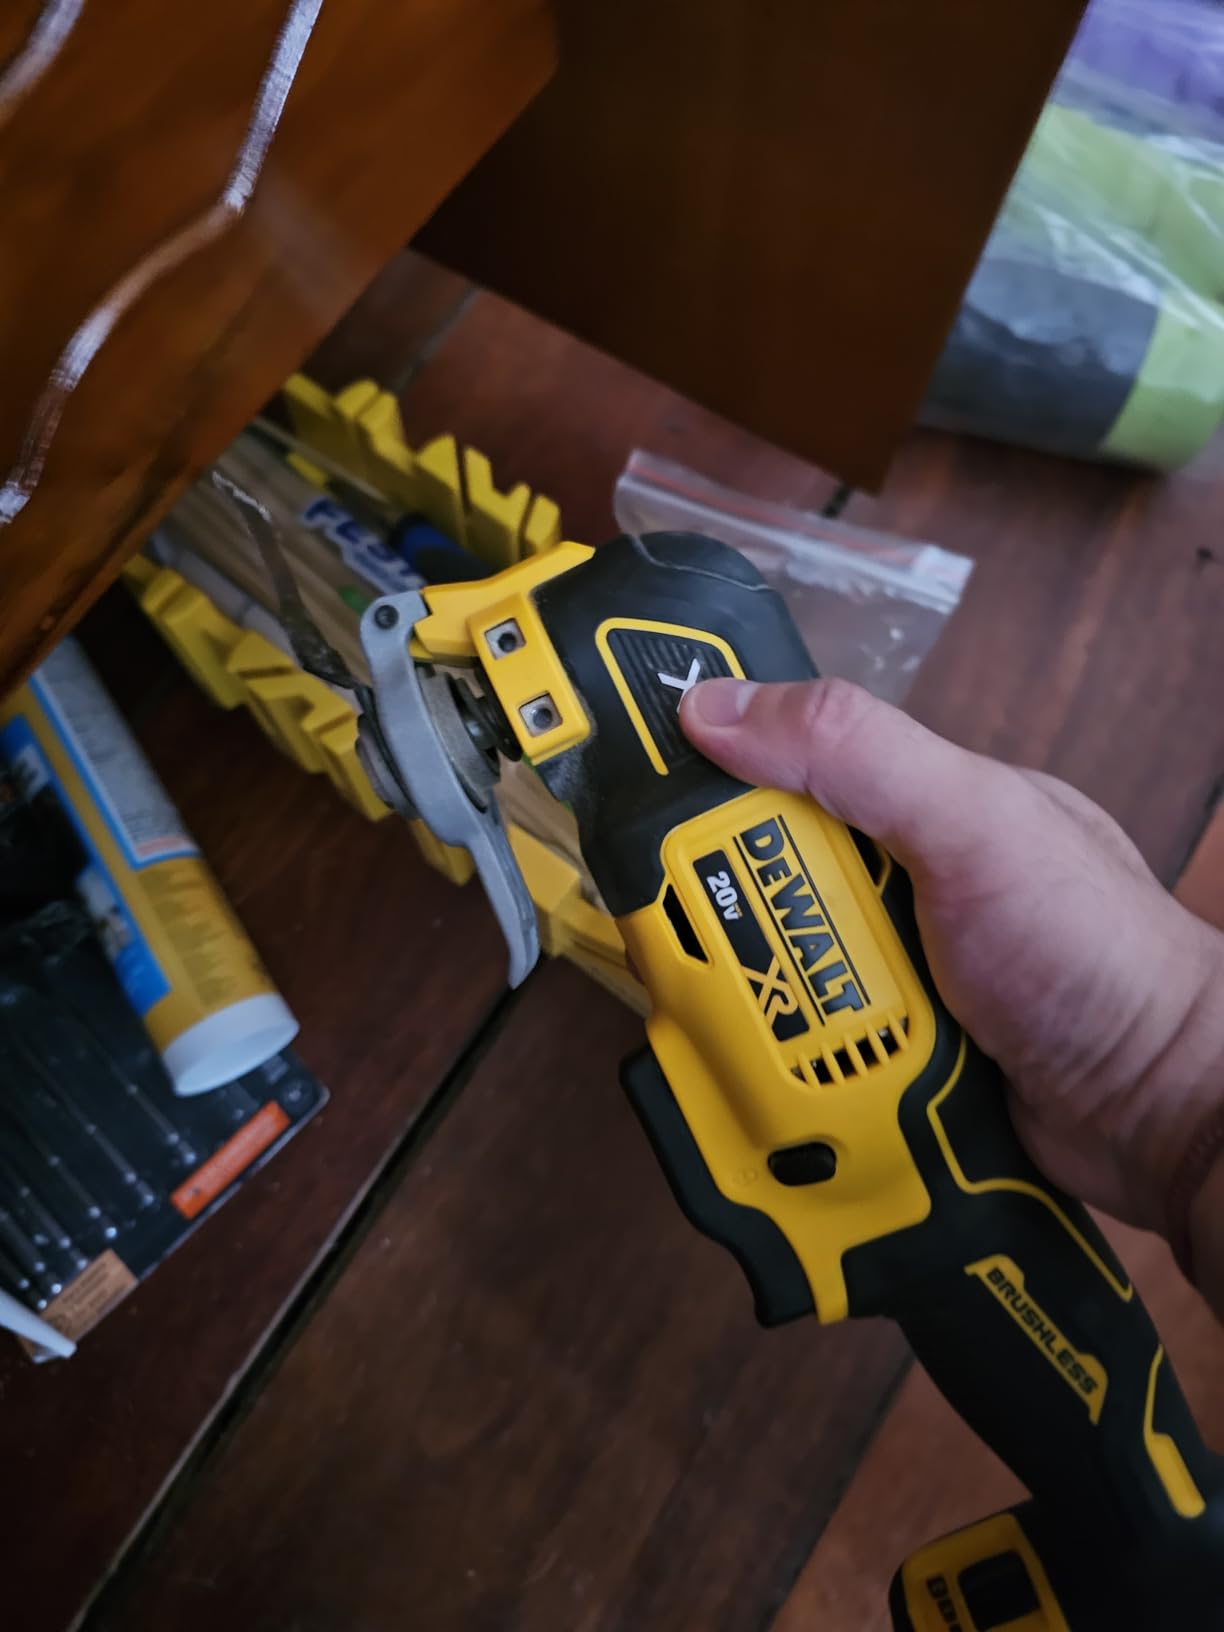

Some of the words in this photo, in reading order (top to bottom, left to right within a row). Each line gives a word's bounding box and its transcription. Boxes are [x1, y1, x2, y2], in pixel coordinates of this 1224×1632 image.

[740, 817, 865, 1016] DEWALT
[740, 956, 799, 1024] XR
[986, 1267, 1098, 1395] BRUSHLESS
